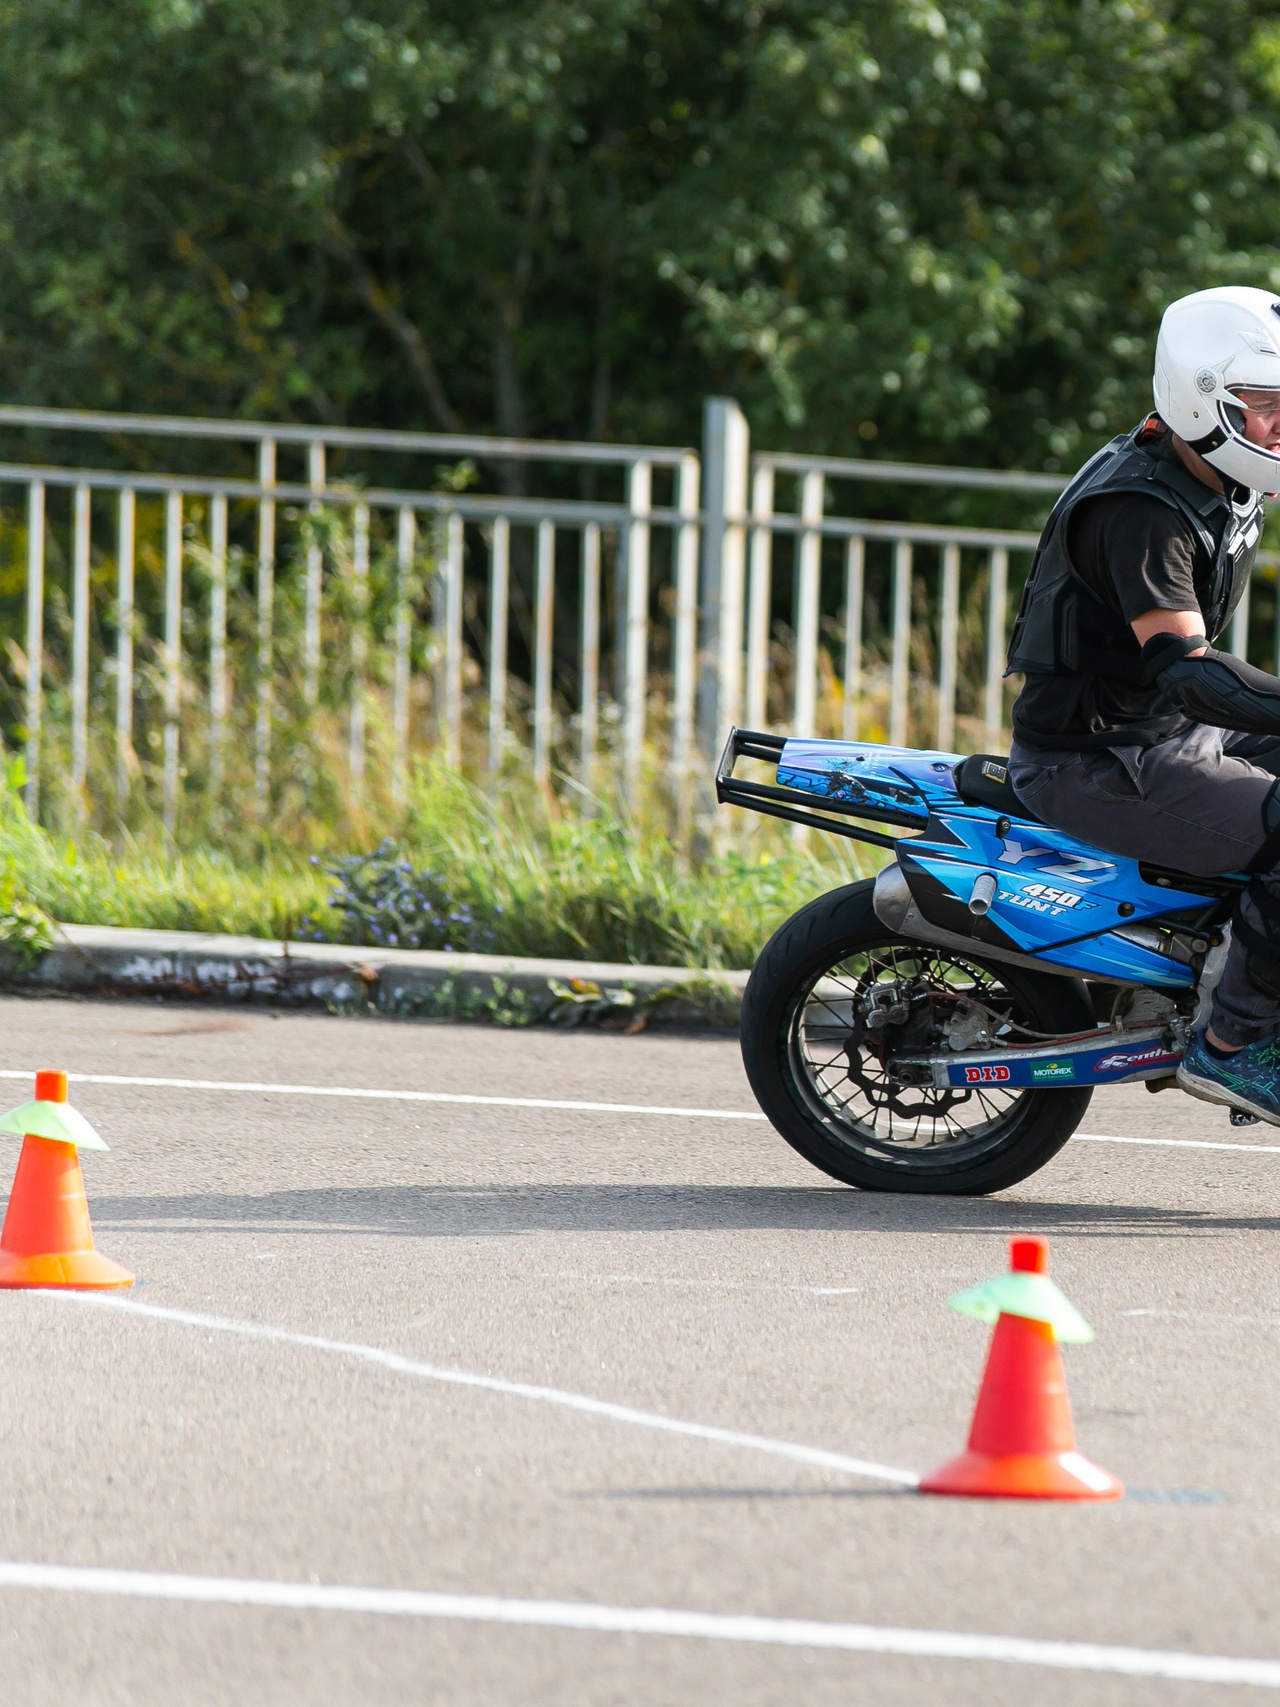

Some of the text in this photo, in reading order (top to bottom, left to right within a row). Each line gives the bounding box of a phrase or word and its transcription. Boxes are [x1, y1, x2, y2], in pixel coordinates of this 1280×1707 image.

[997, 838, 1116, 884] YZ
[996, 890, 1068, 916] TUNT
[1098, 1048, 1174, 1070] Renth
[1033, 1067, 1073, 1076] MOTOREX
